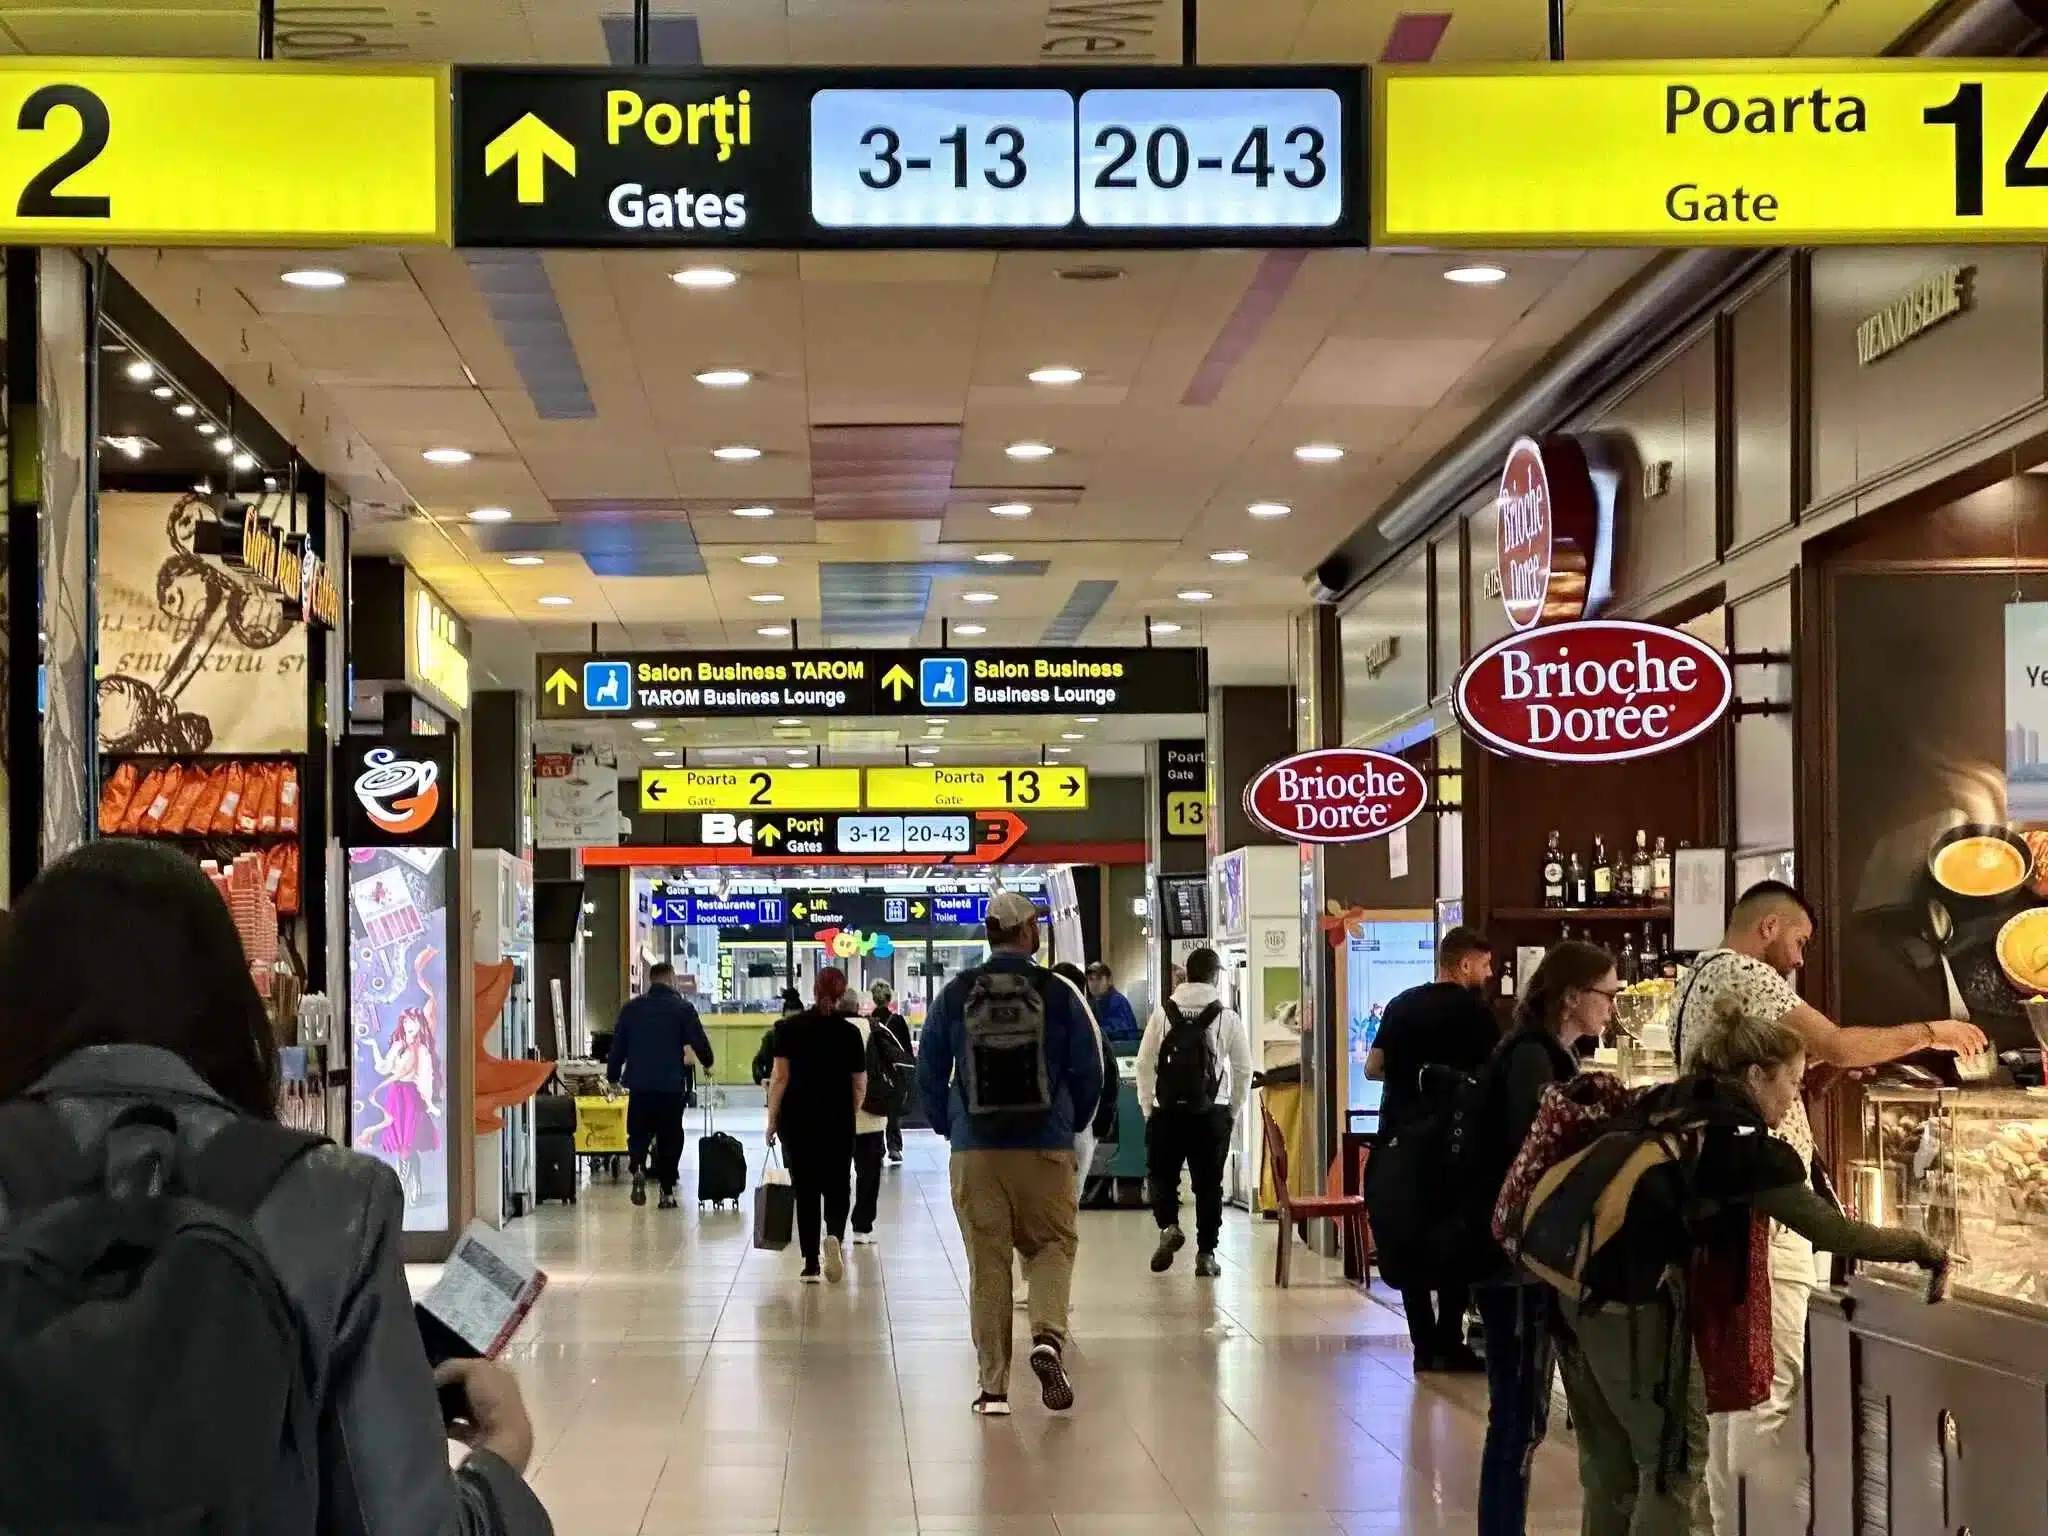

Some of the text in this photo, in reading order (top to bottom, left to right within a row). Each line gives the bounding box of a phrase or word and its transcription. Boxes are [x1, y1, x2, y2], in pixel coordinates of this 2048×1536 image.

[1665, 84, 1867, 134] Poarta
[607, 89, 750, 162] Porți
[16, 84, 111, 218] 2
[858, 125, 1027, 190] 3-13
[1094, 125, 1327, 190] 20-43
[608, 183, 747, 228] Gates
[1665, 183, 1779, 222] Gate
[1503, 464, 1544, 553] Brioche
[638, 661, 865, 682] Salon Business TAROM
[974, 660, 1124, 679] Salon Business
[1499, 639, 1698, 700] Brioche
[638, 688, 846, 708] TAROM Business Lounge
[974, 686, 1116, 706] Business Lounge
[1526, 692, 1670, 744] Dorée
[1168, 769, 1194, 780] Gate
[1277, 762, 1406, 802] Brioche
[687, 772, 772, 805] Poarta 2
[935, 770, 1041, 804] Poarta 13
[687, 795, 716, 806] Gate
[935, 794, 965, 805] Gate
[1174, 801, 1204, 825] 13
[1295, 795, 1389, 830] Dorée
[849, 826, 891, 842] 3-12
[907, 826, 966, 842] 20-43
[787, 840, 823, 853] Gates
[696, 900, 756, 911] Restaurante
[810, 899, 828, 910] Lift
[697, 914, 739, 924] Food court
[810, 913, 843, 923] Elevator
[934, 913, 958, 921] Toilet
